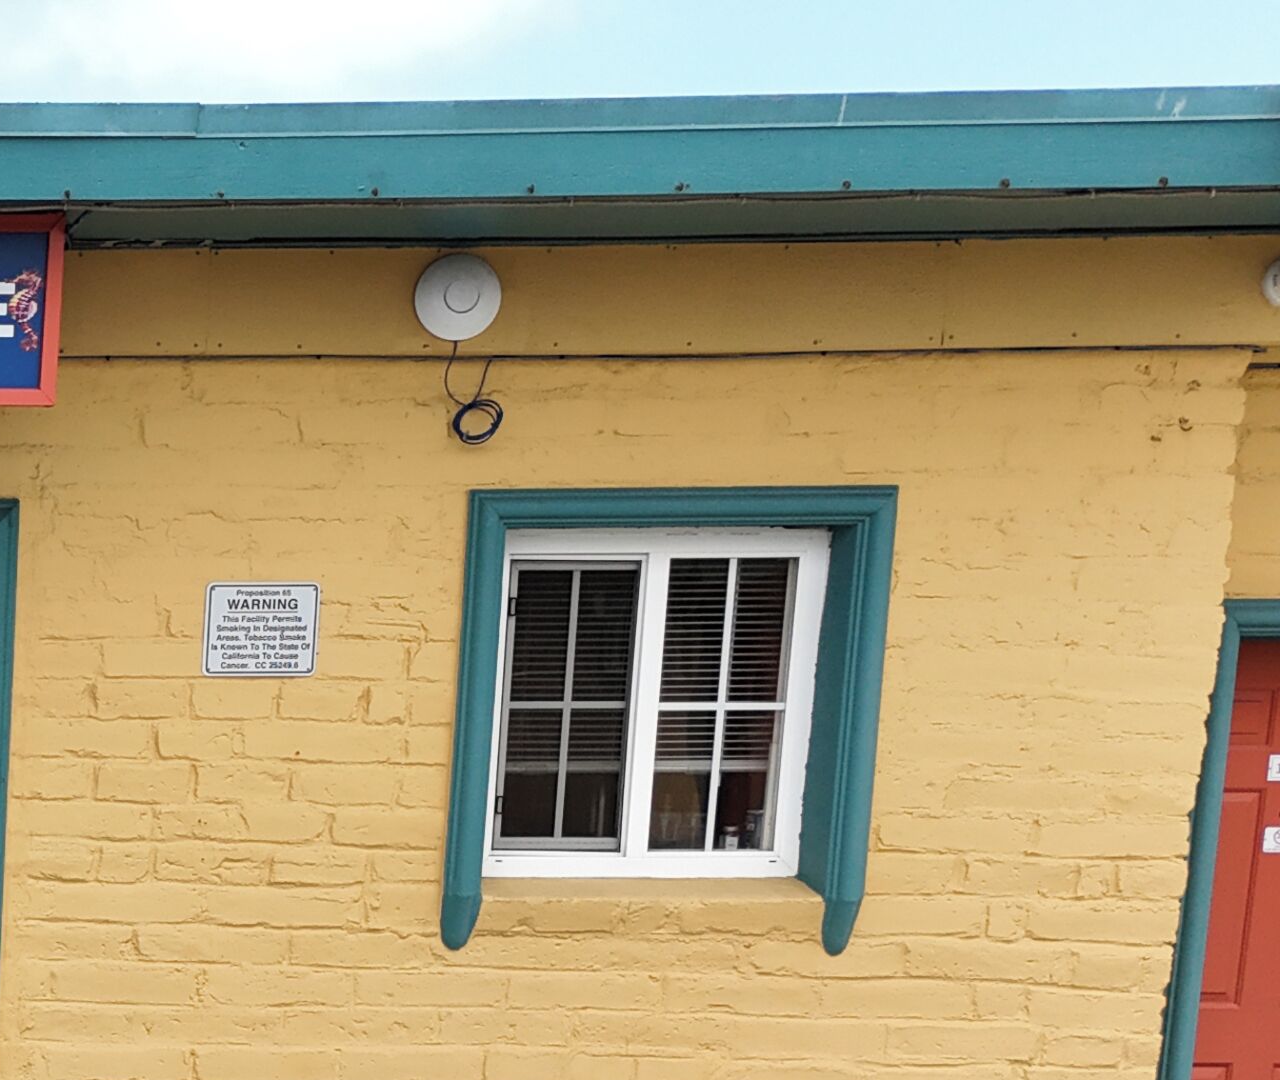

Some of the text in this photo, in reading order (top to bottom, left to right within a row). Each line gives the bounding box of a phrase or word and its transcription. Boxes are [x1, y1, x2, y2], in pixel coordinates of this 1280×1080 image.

[236, 589, 280, 597] Proposition
[227, 598, 298, 610] WARNING
[222, 615, 302, 624] This Facility Permits
[216, 625, 251, 633] Smoking
[263, 625, 307, 633] Designated
[279, 633, 306, 641] Smoke
[211, 643, 311, 651] Is Known To The State Of
[221, 652, 299, 660] California To Cause
[255, 661, 267, 669] CC
